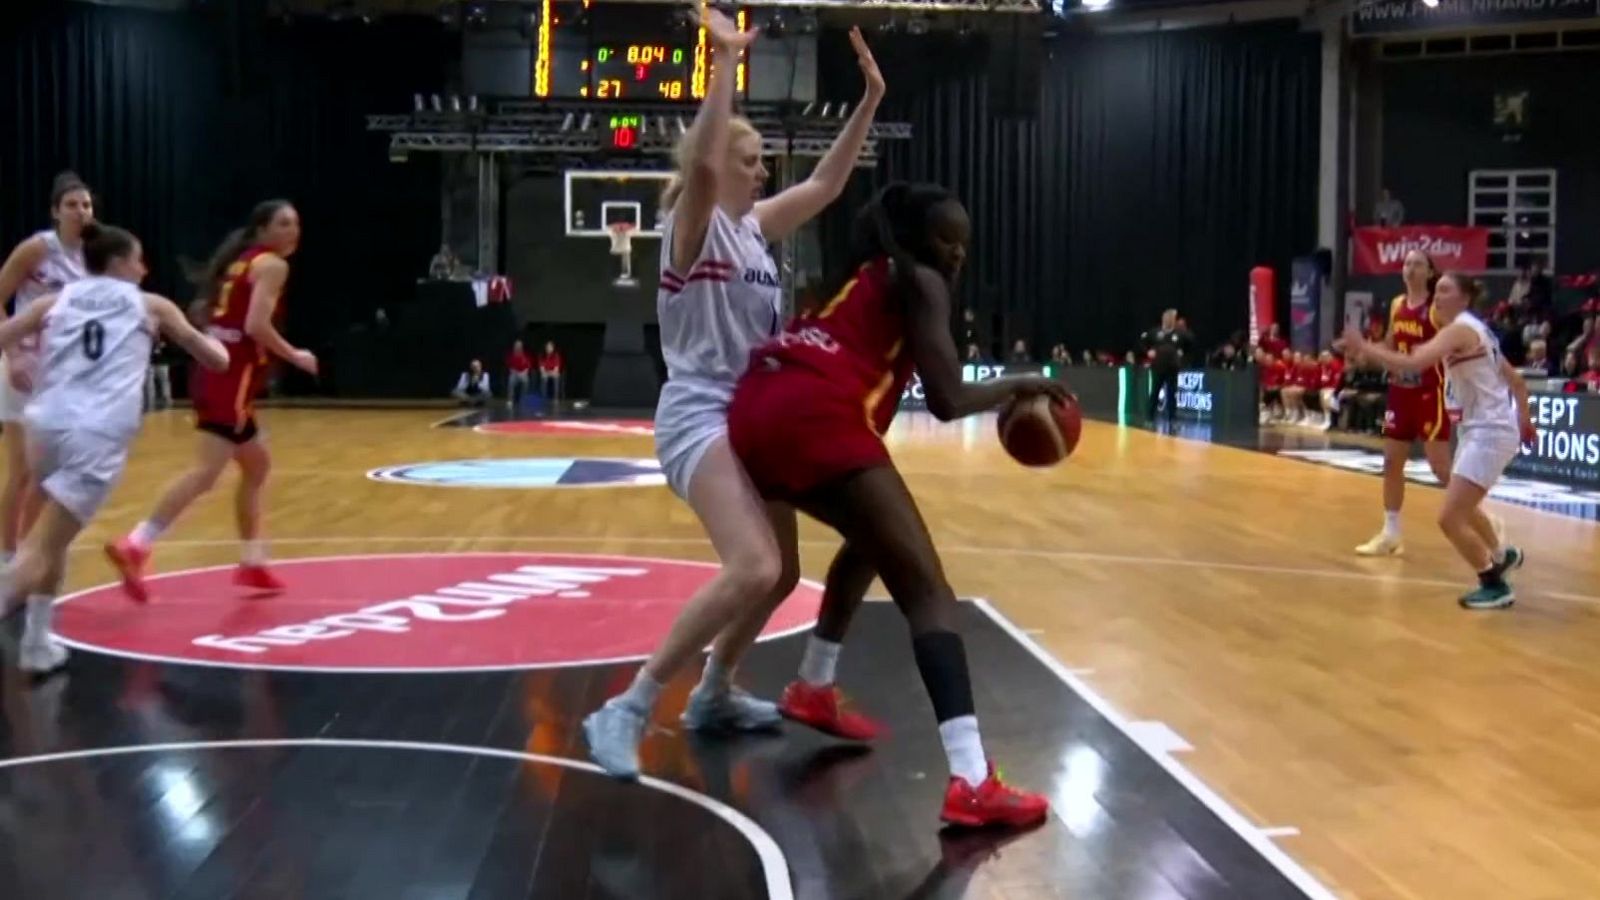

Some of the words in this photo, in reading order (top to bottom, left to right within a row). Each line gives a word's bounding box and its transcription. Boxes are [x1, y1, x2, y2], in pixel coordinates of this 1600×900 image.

[673, 49, 682, 64] 0
[597, 80, 620, 98] 27
[659, 81, 681, 98] 48
[614, 128, 630, 146] 10
[83, 319, 104, 361] 0
